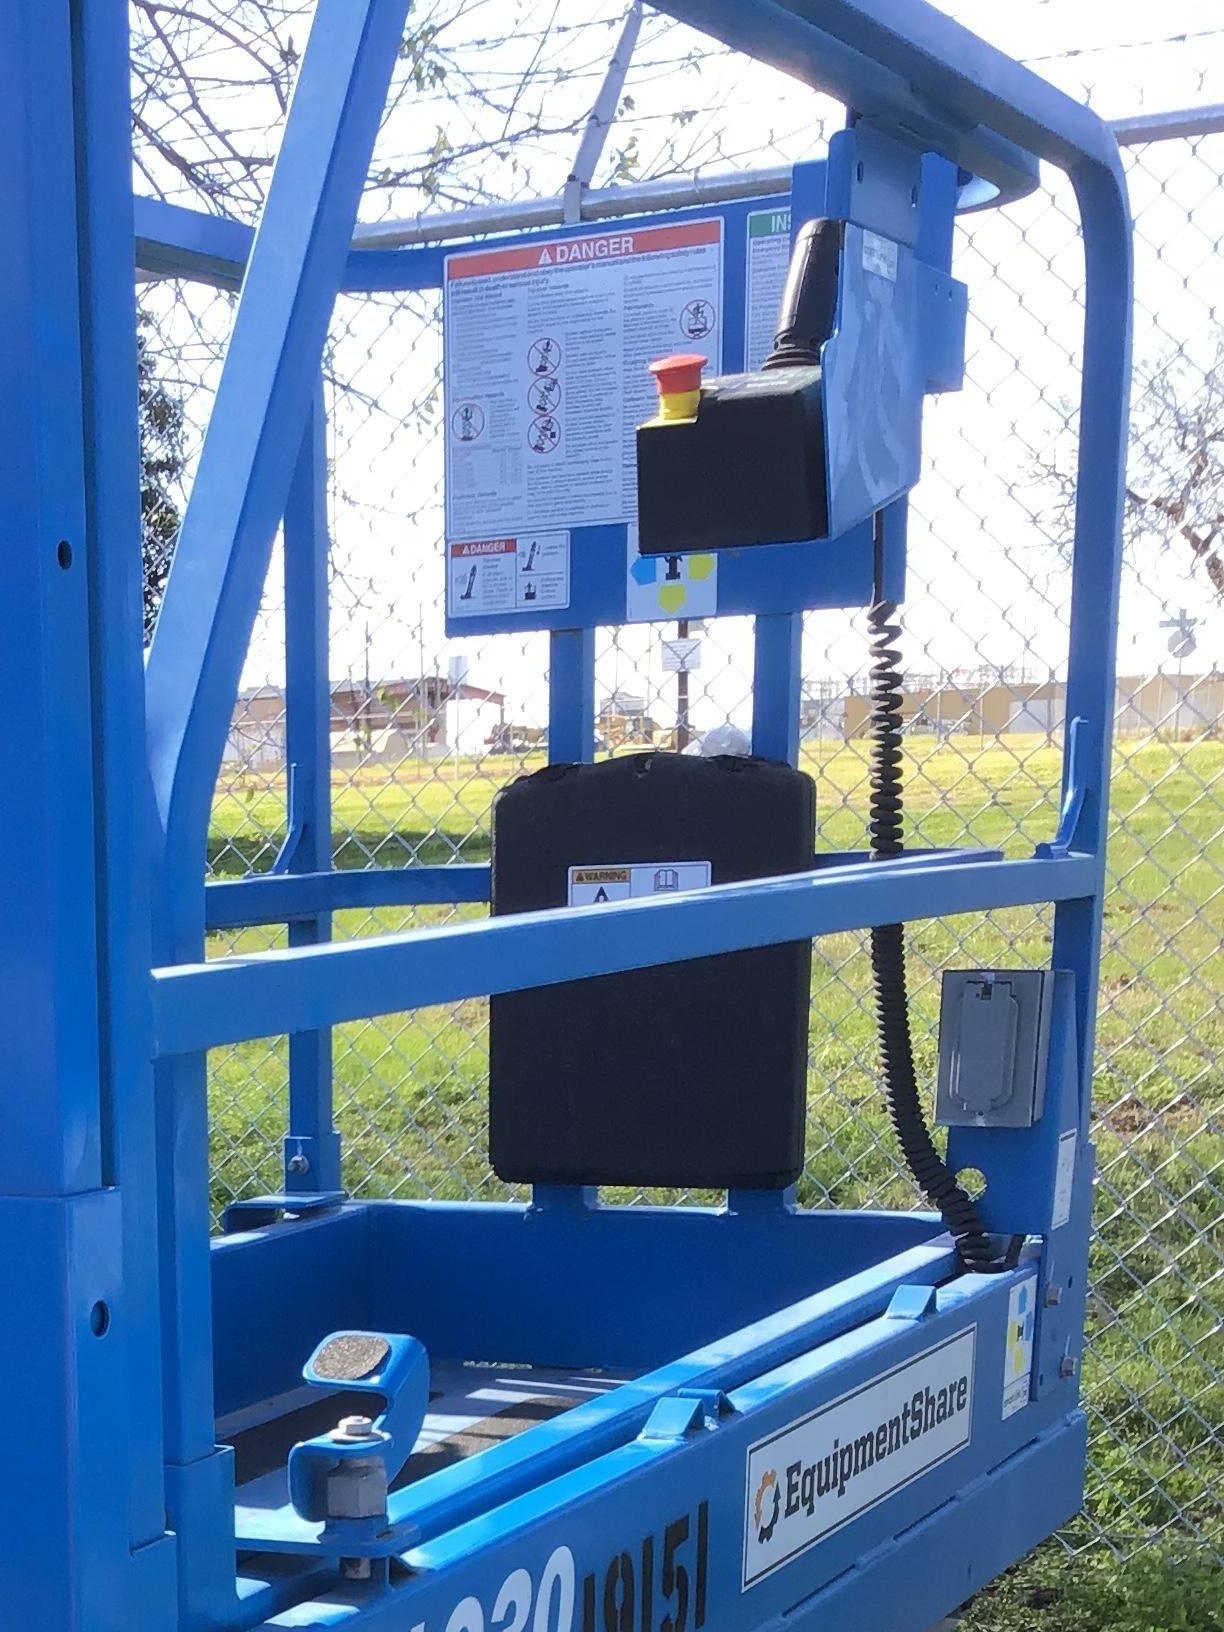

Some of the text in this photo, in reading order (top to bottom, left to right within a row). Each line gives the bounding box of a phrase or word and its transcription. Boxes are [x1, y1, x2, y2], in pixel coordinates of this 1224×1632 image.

[556, 236, 634, 264] DANGER
[469, 542, 506, 554] DANGER
[585, 871, 627, 881] WARNING
[784, 1375, 968, 1519] EquipmentShare
